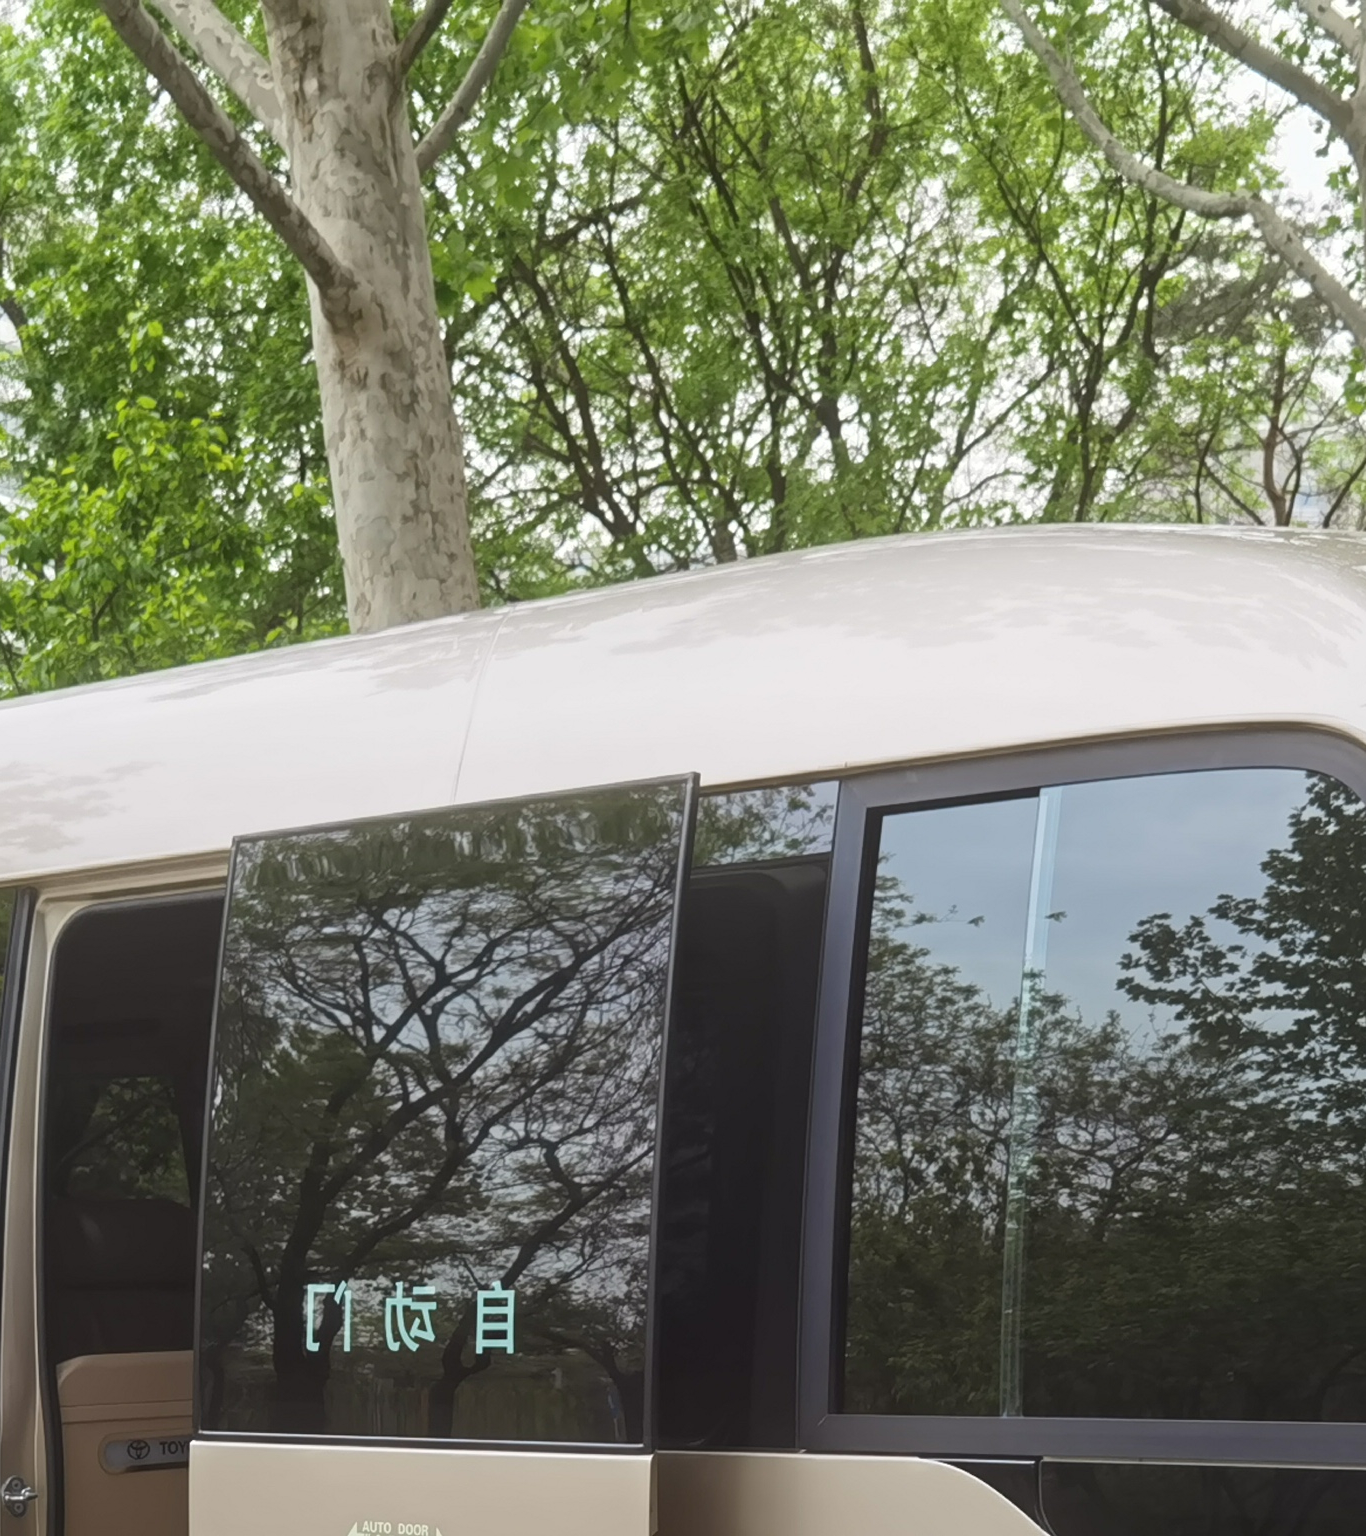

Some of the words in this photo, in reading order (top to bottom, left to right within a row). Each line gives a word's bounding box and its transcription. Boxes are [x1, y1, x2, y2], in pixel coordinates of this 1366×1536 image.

[159, 1440, 188, 1455] TOY
[362, 1520, 392, 1534] AUTO
[398, 1523, 429, 1536] DOOR
